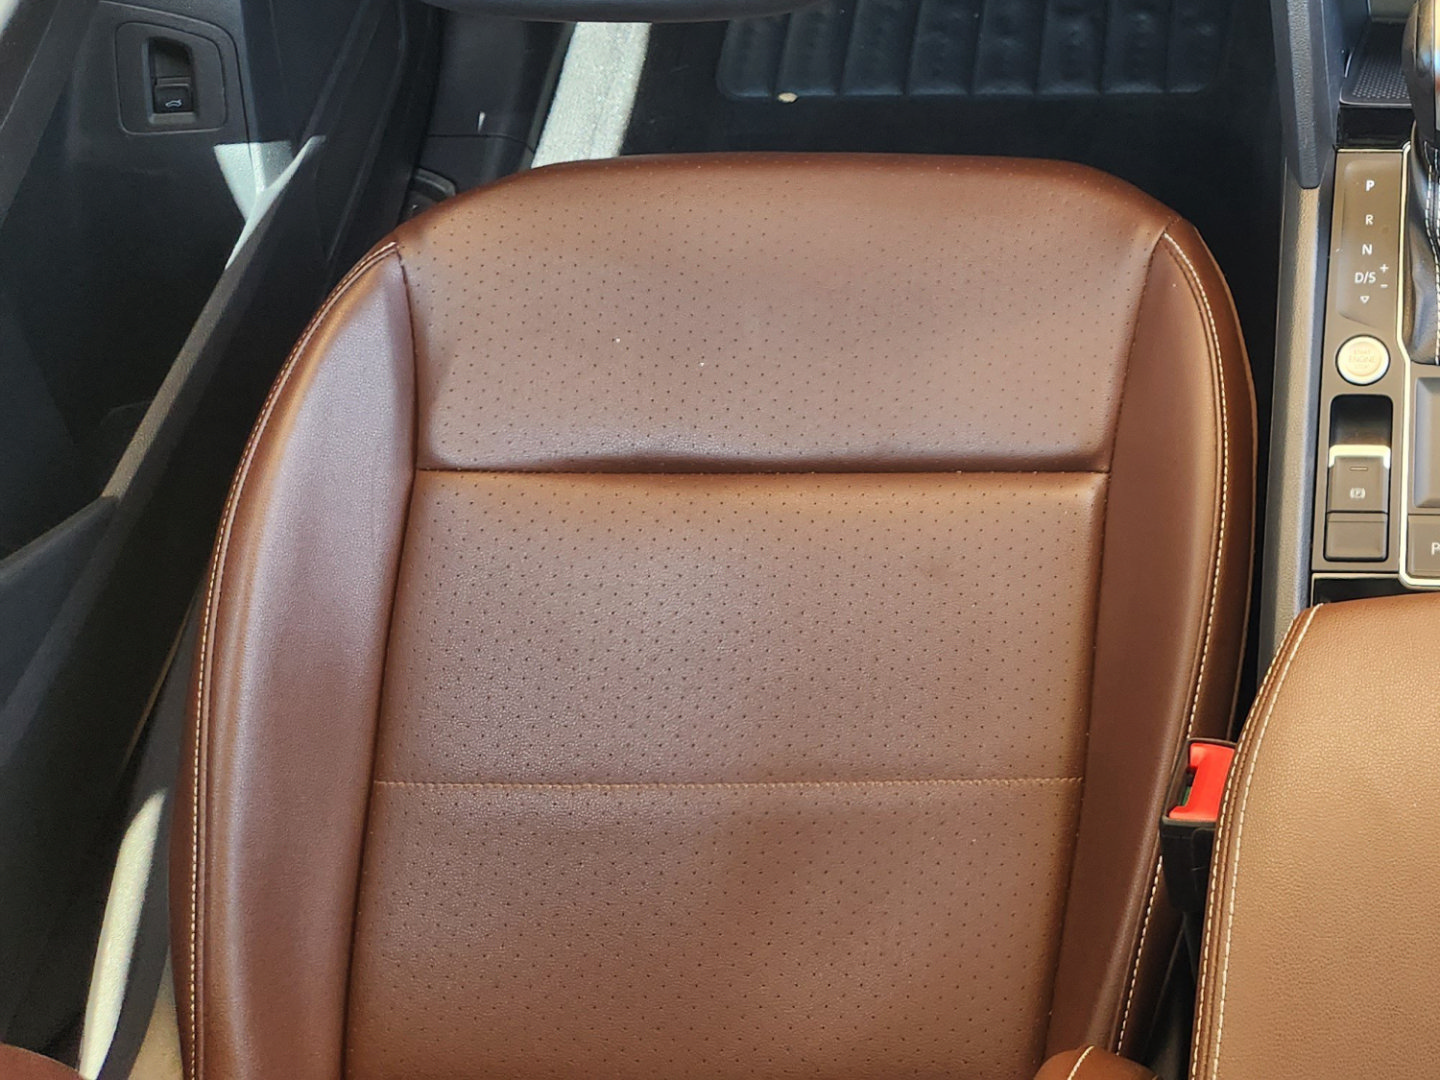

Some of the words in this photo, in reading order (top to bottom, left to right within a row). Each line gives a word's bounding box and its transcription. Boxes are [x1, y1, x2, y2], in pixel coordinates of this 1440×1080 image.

[1365, 180, 1375, 192] P
[1365, 214, 1374, 225] R
[1362, 244, 1373, 255] N
[1354, 270, 1376, 284] D/S
